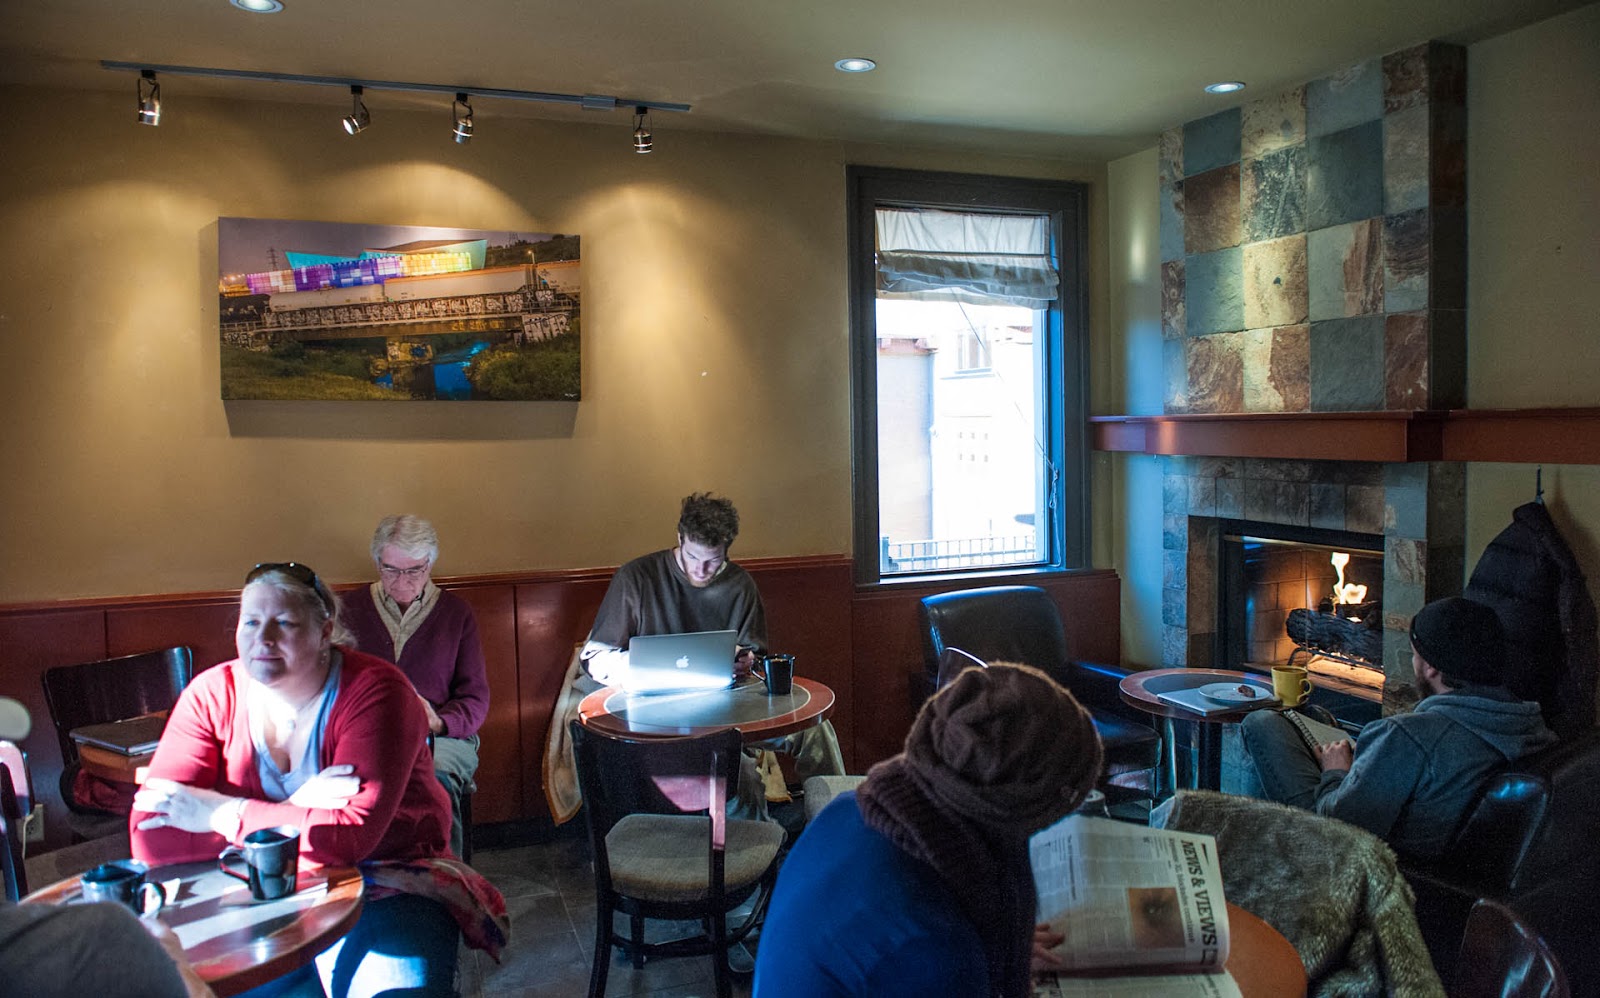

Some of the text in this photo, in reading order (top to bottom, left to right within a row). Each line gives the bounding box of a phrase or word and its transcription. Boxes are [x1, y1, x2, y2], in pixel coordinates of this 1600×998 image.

[1180, 839, 1204, 876] NEWS
[1191, 877, 1206, 888] &
[1194, 888, 1218, 946] VIEWS
